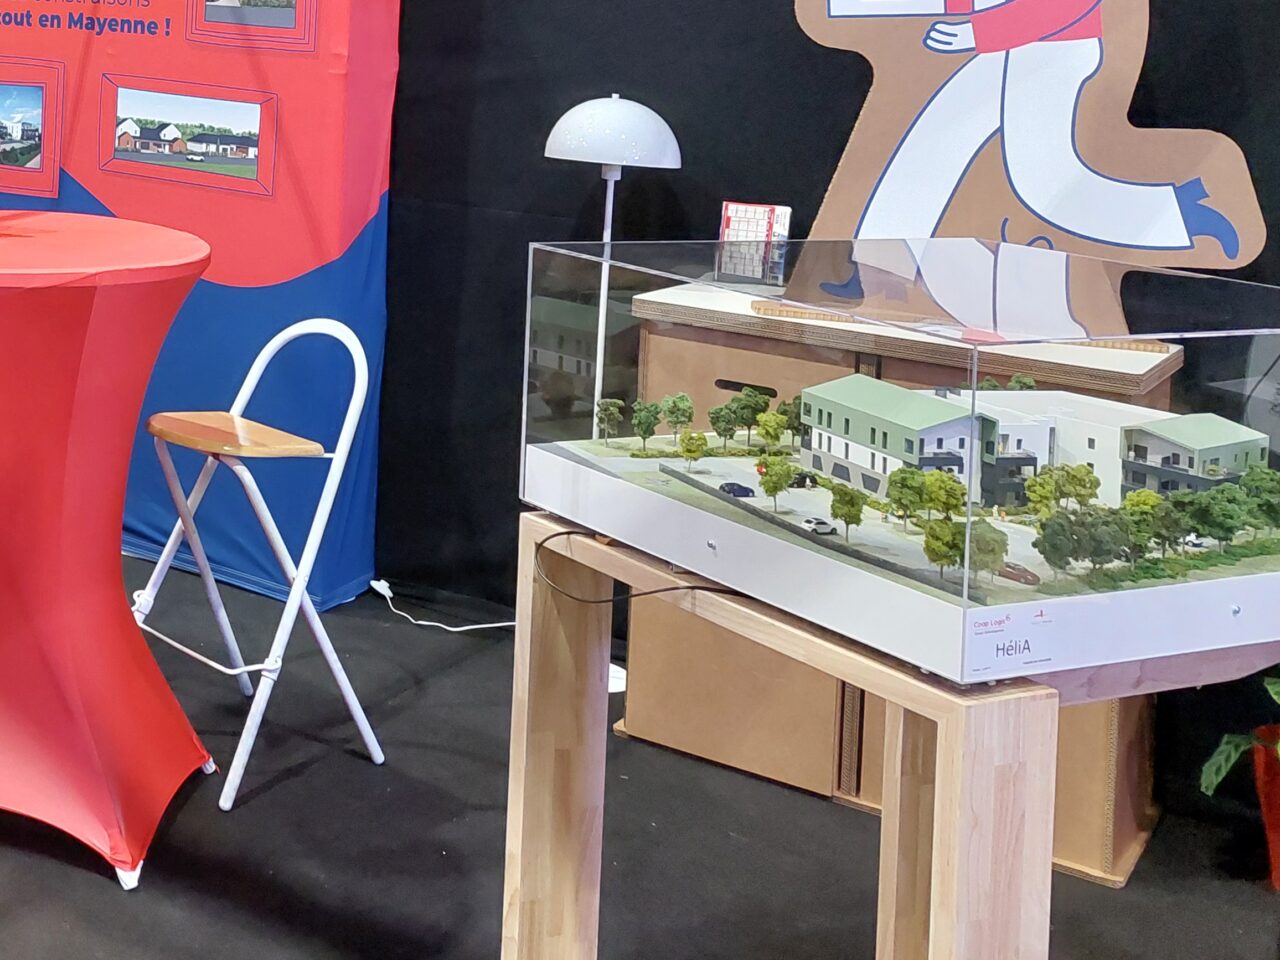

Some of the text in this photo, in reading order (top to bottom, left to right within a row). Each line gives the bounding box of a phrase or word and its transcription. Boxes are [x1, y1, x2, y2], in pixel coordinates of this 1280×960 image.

[38, 13, 62, 29] en
[68, 11, 160, 36] Mayenne
[164, 17, 172, 37] !
[995, 639, 1031, 658] HéliA
